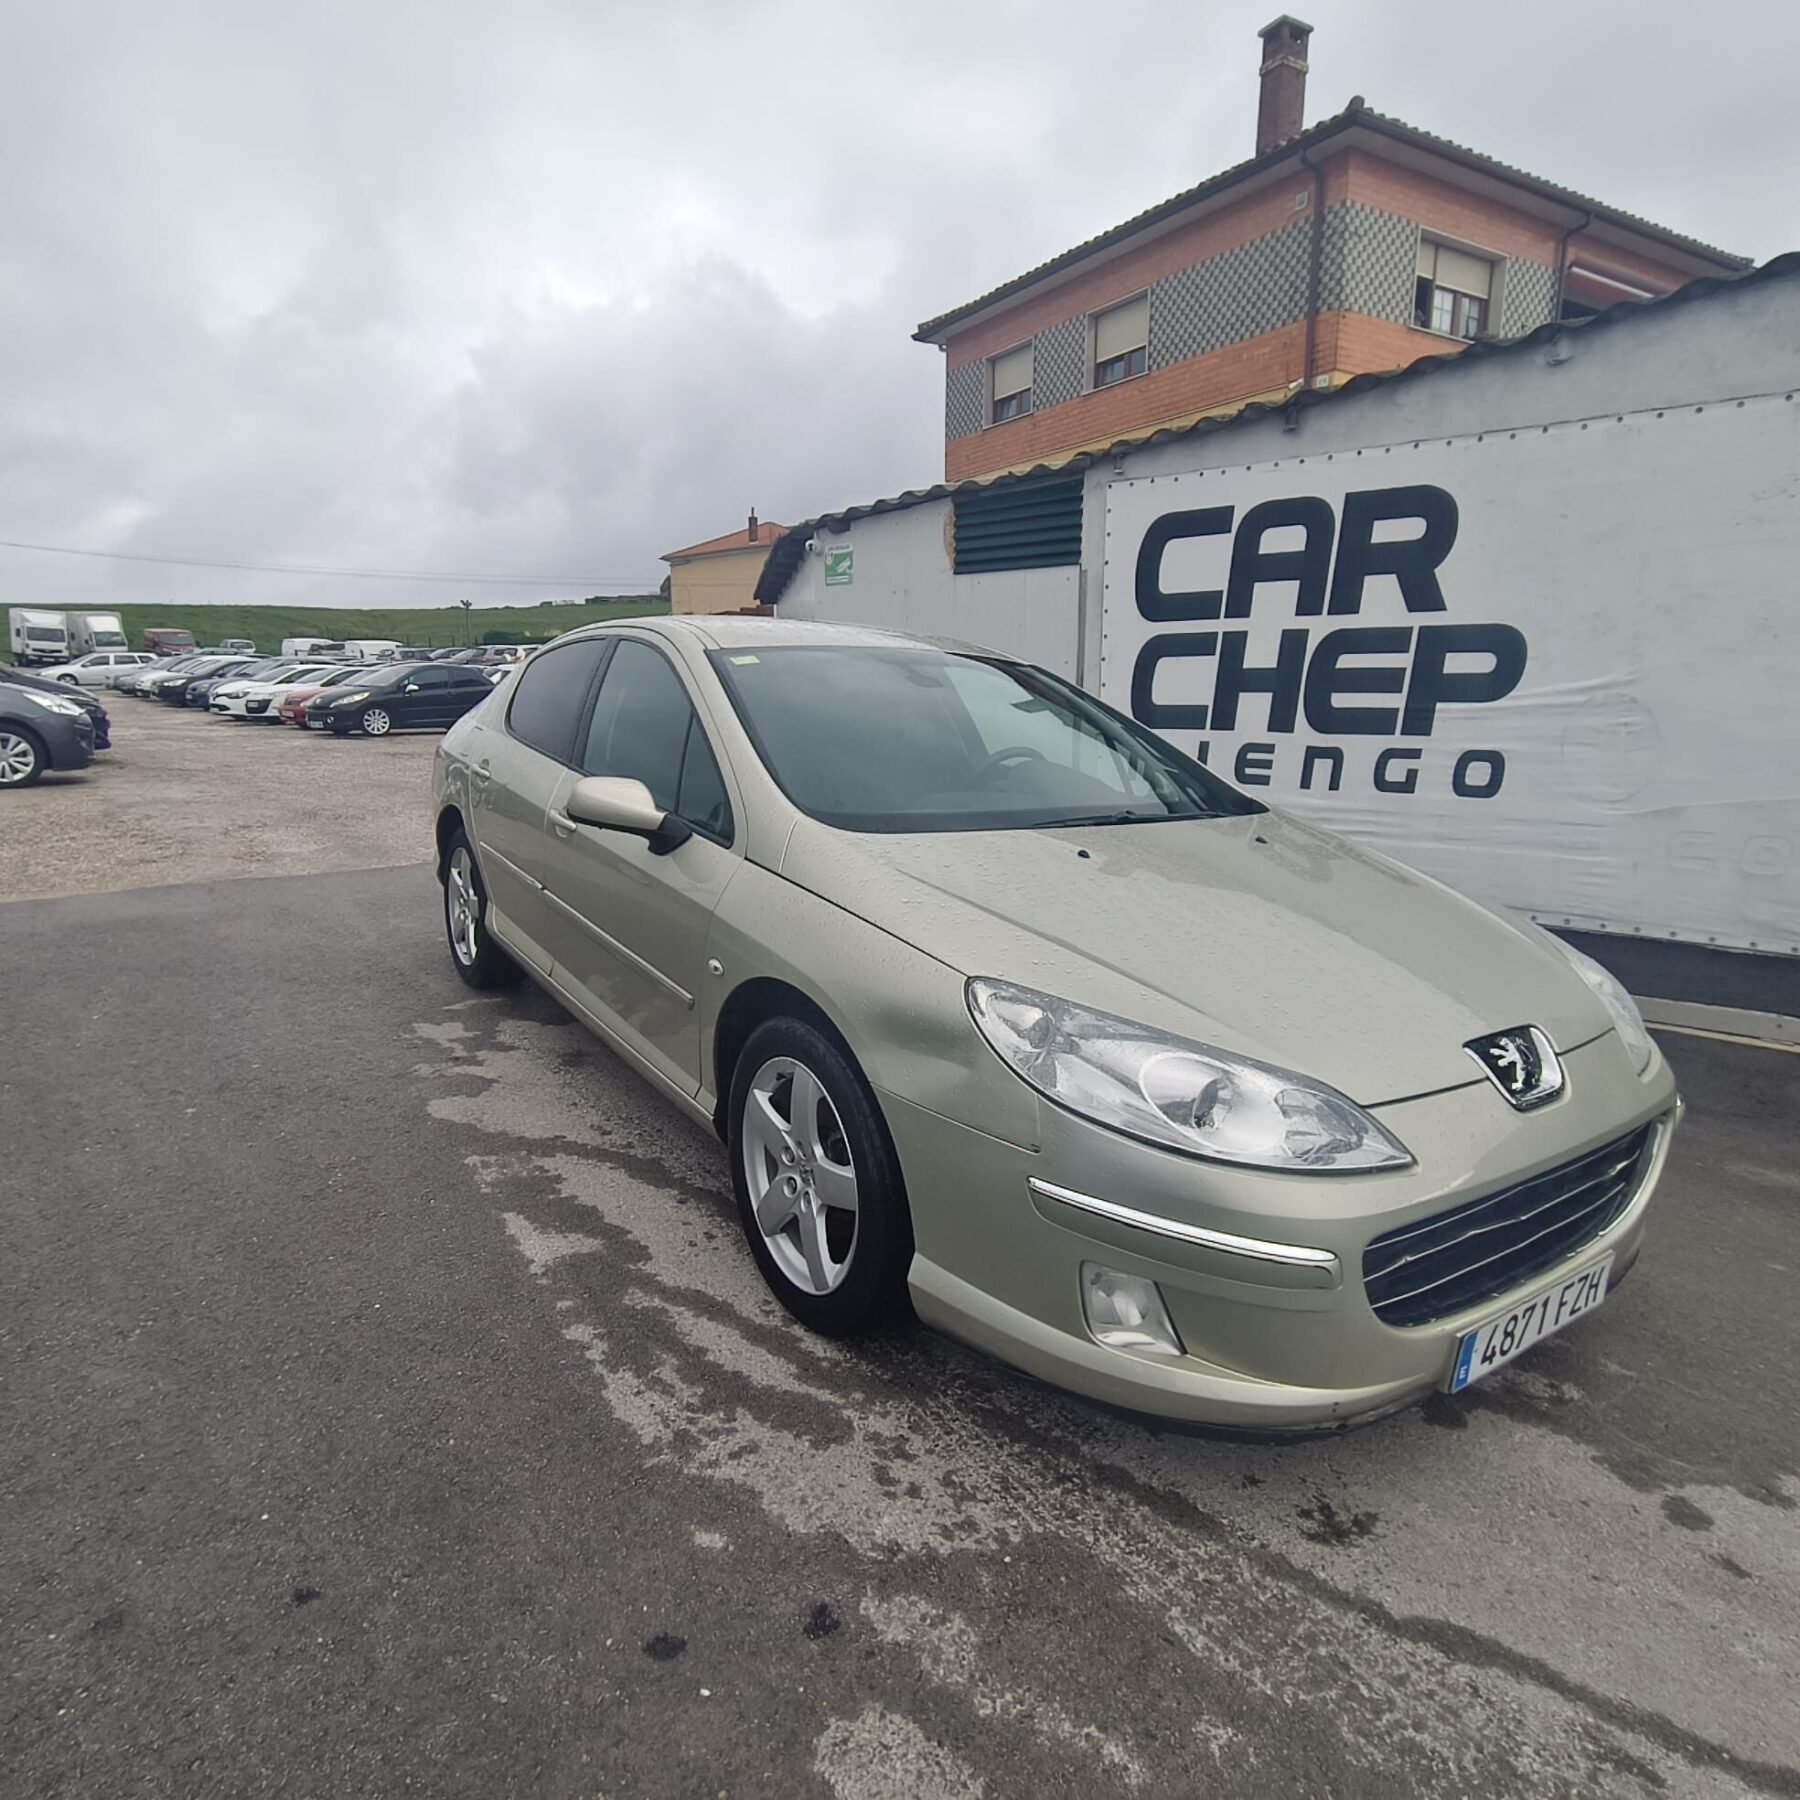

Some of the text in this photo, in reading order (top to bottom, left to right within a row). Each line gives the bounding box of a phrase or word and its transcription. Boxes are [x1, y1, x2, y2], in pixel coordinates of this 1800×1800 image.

[1134, 484, 1459, 623] CAR
[1130, 623, 1528, 737] CHEP
[1480, 1266, 1605, 1366] 4871 FZH
